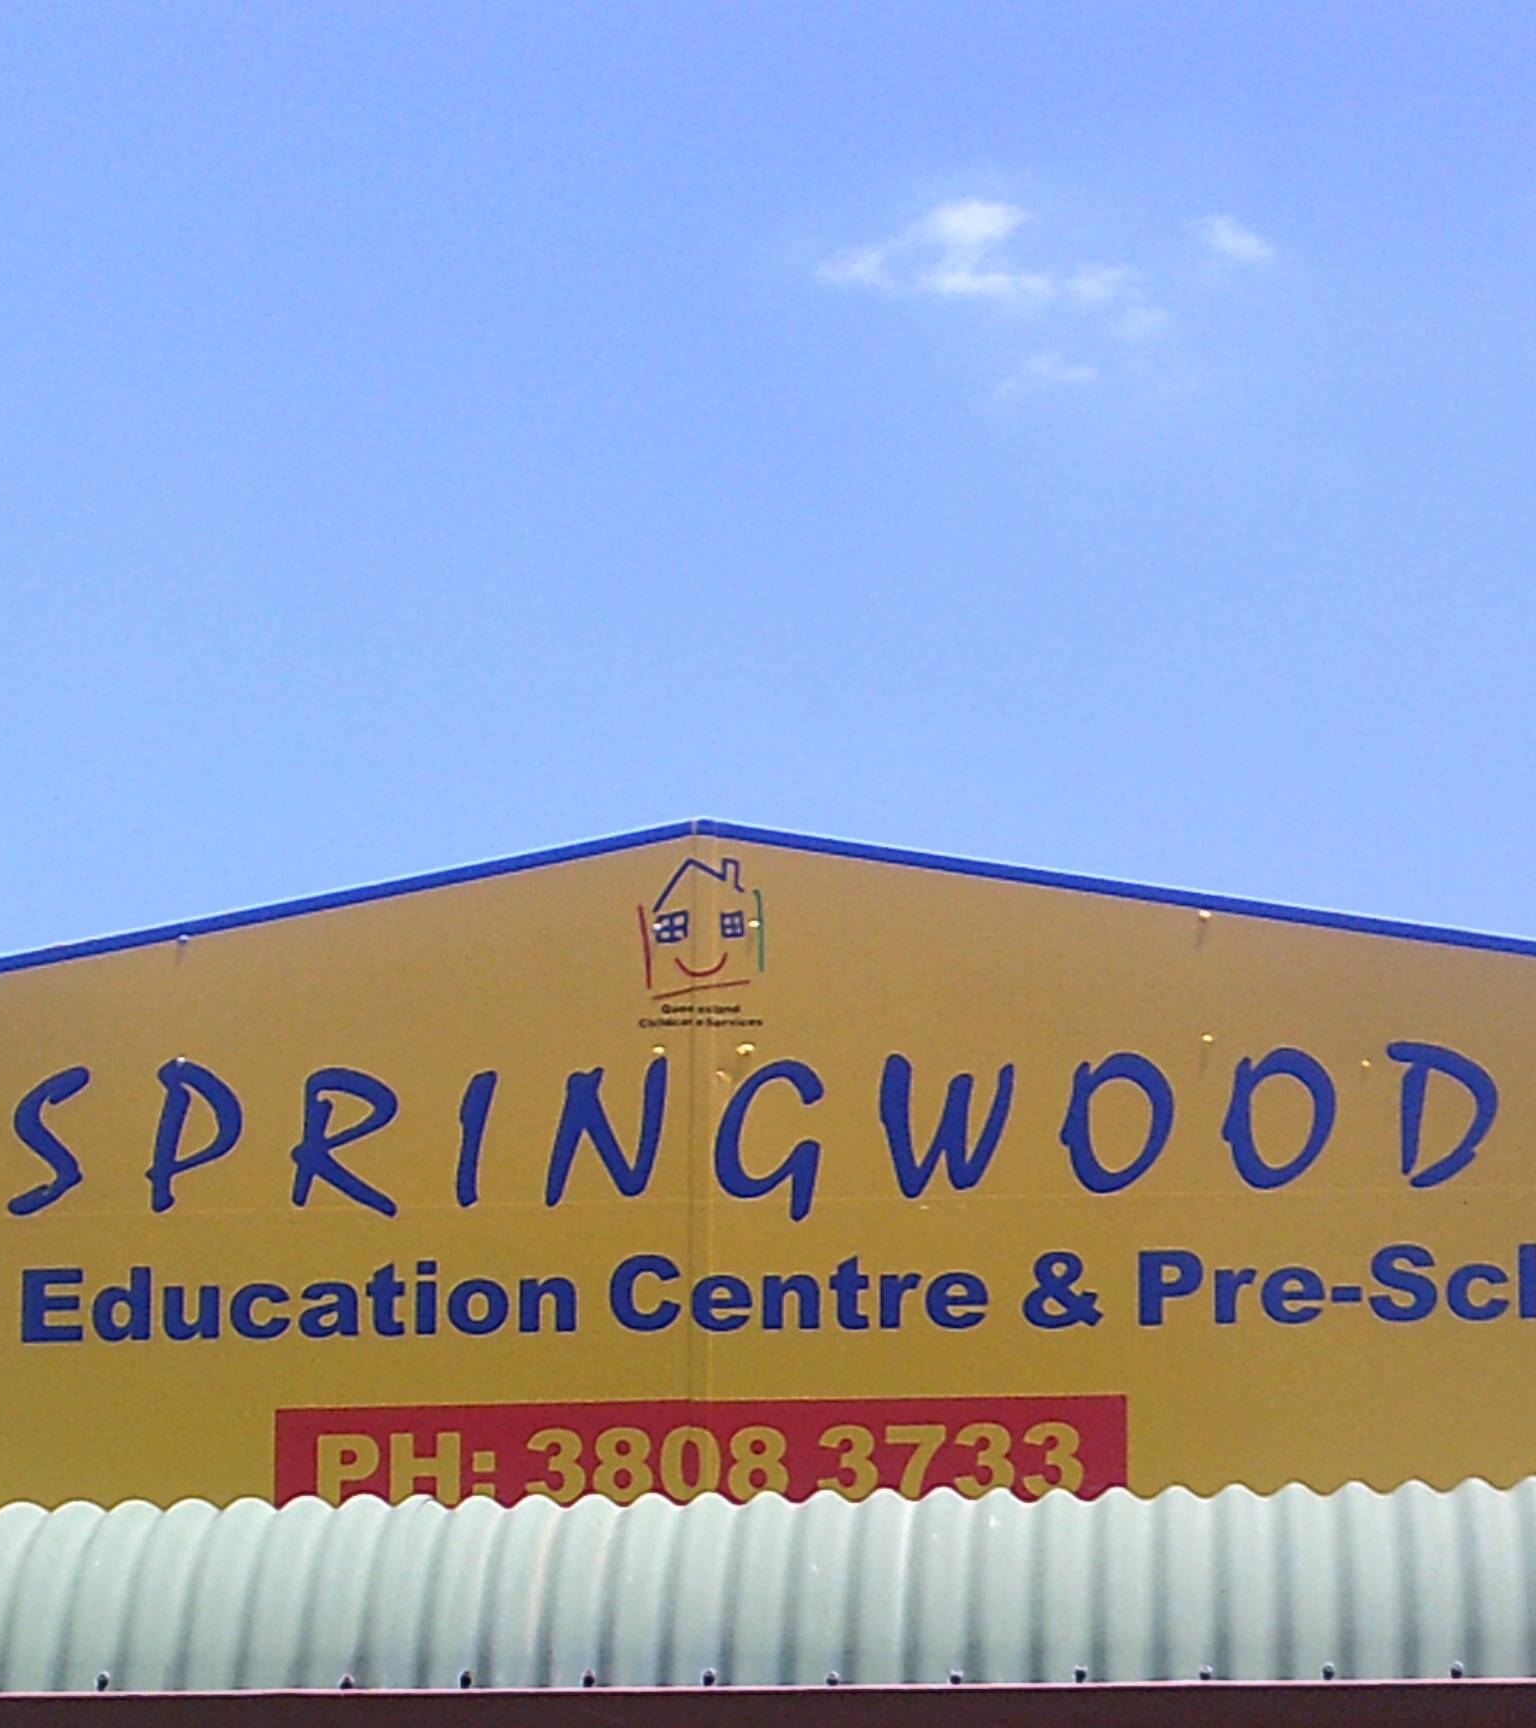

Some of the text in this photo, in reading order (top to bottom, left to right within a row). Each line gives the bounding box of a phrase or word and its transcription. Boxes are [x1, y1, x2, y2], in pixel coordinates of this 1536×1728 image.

[7, 1042, 1499, 1222] SPRINGWOOD
[19, 1260, 577, 1344] Education
[608, 1254, 989, 1332] Centre
[1022, 1251, 1103, 1329] &
[316, 1420, 1085, 1505] PH: 3808 3733
